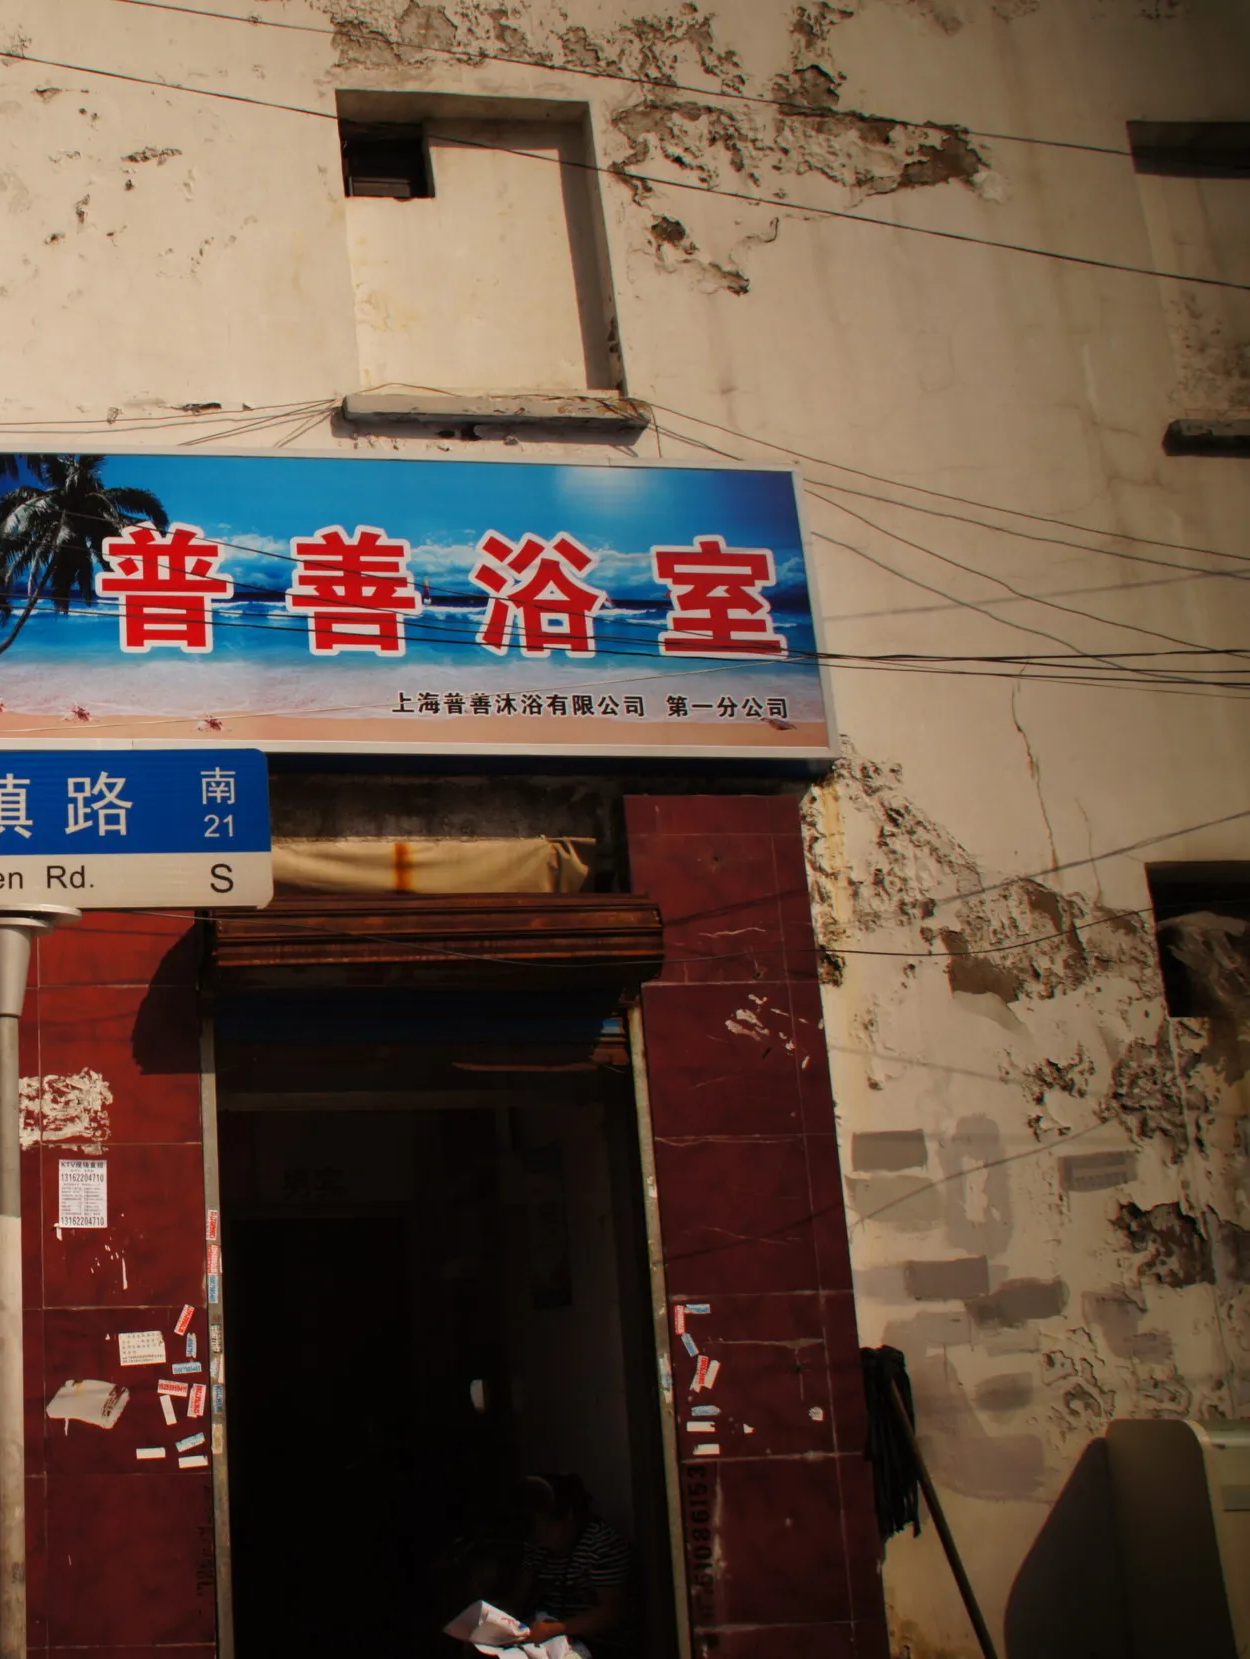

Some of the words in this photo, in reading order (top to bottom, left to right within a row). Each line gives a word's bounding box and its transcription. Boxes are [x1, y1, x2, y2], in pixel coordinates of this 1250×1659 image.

[101, 526, 784, 655] 普善浴室
[391, 691, 645, 717] 上海普善沐浴有限公司
[666, 695, 788, 719] 第一分公司
[200, 766, 237, 805] 南
[203, 814, 234, 838] 21
[46, 865, 95, 889] Rd.
[210, 863, 235, 894] S
[60, 1173, 104, 1182] 13162204710
[60, 1216, 105, 1226] 13162204710
